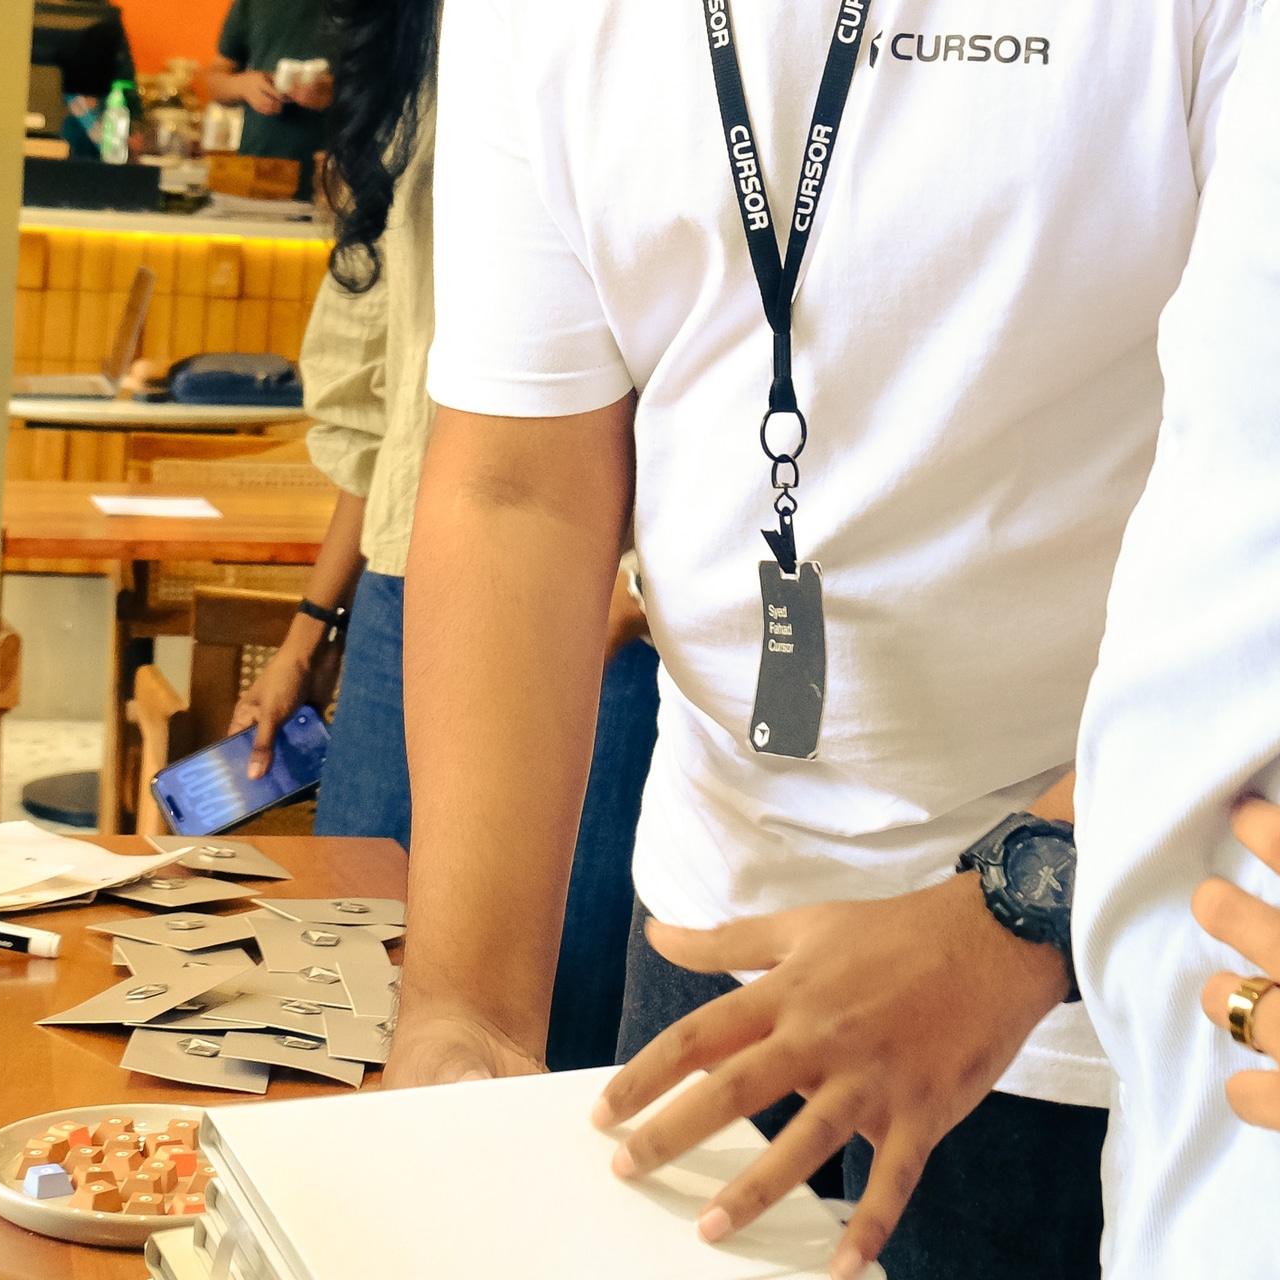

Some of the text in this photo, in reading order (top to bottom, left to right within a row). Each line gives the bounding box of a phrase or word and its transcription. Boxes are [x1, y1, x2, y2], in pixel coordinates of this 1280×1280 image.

[891, 33, 1050, 65] CURSOR
[729, 124, 770, 231] CURSOR
[795, 123, 833, 232] CURSOR
[768, 604, 788, 620] Syed
